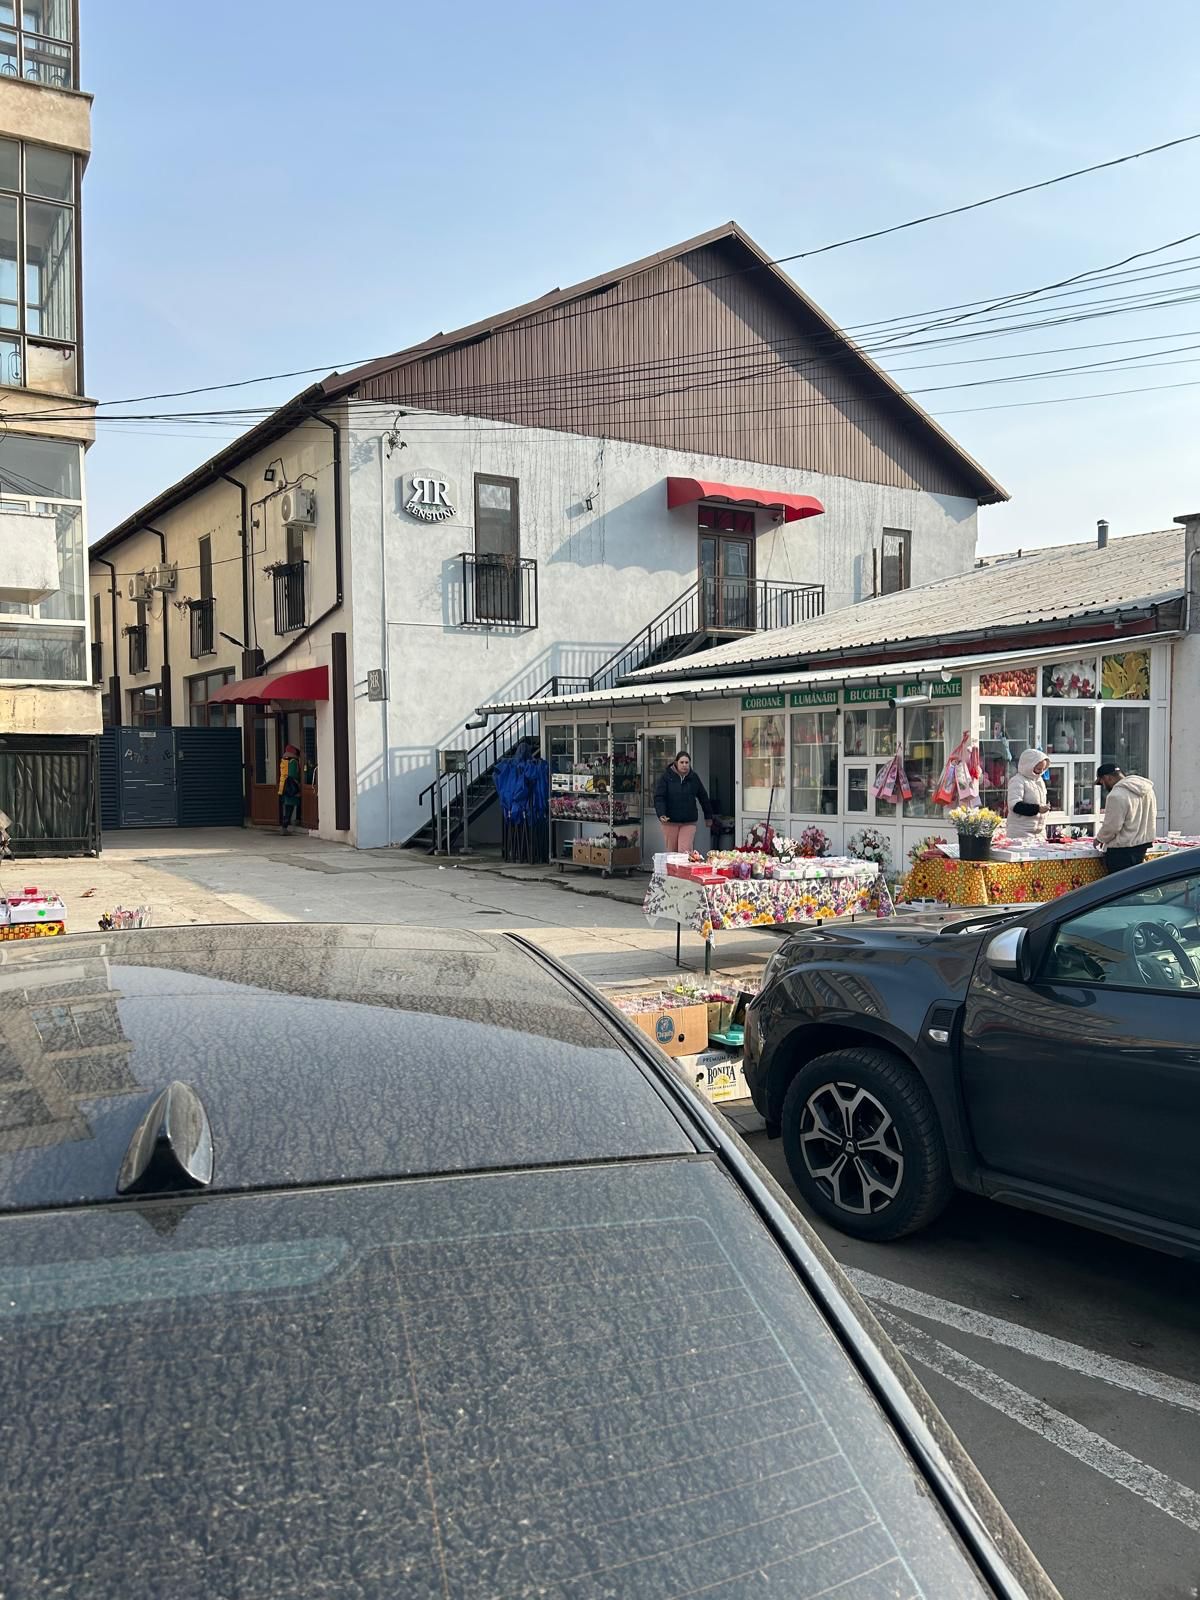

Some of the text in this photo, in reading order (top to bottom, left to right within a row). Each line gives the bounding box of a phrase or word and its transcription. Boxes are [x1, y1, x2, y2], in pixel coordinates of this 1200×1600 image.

[405, 502, 457, 521] PENSIUNE
[850, 688, 893, 701] BUCHETE
[906, 682, 961, 696] ARAAMENTE
[745, 696, 782, 708] COROANE
[707, 1065, 736, 1084] BONITA
